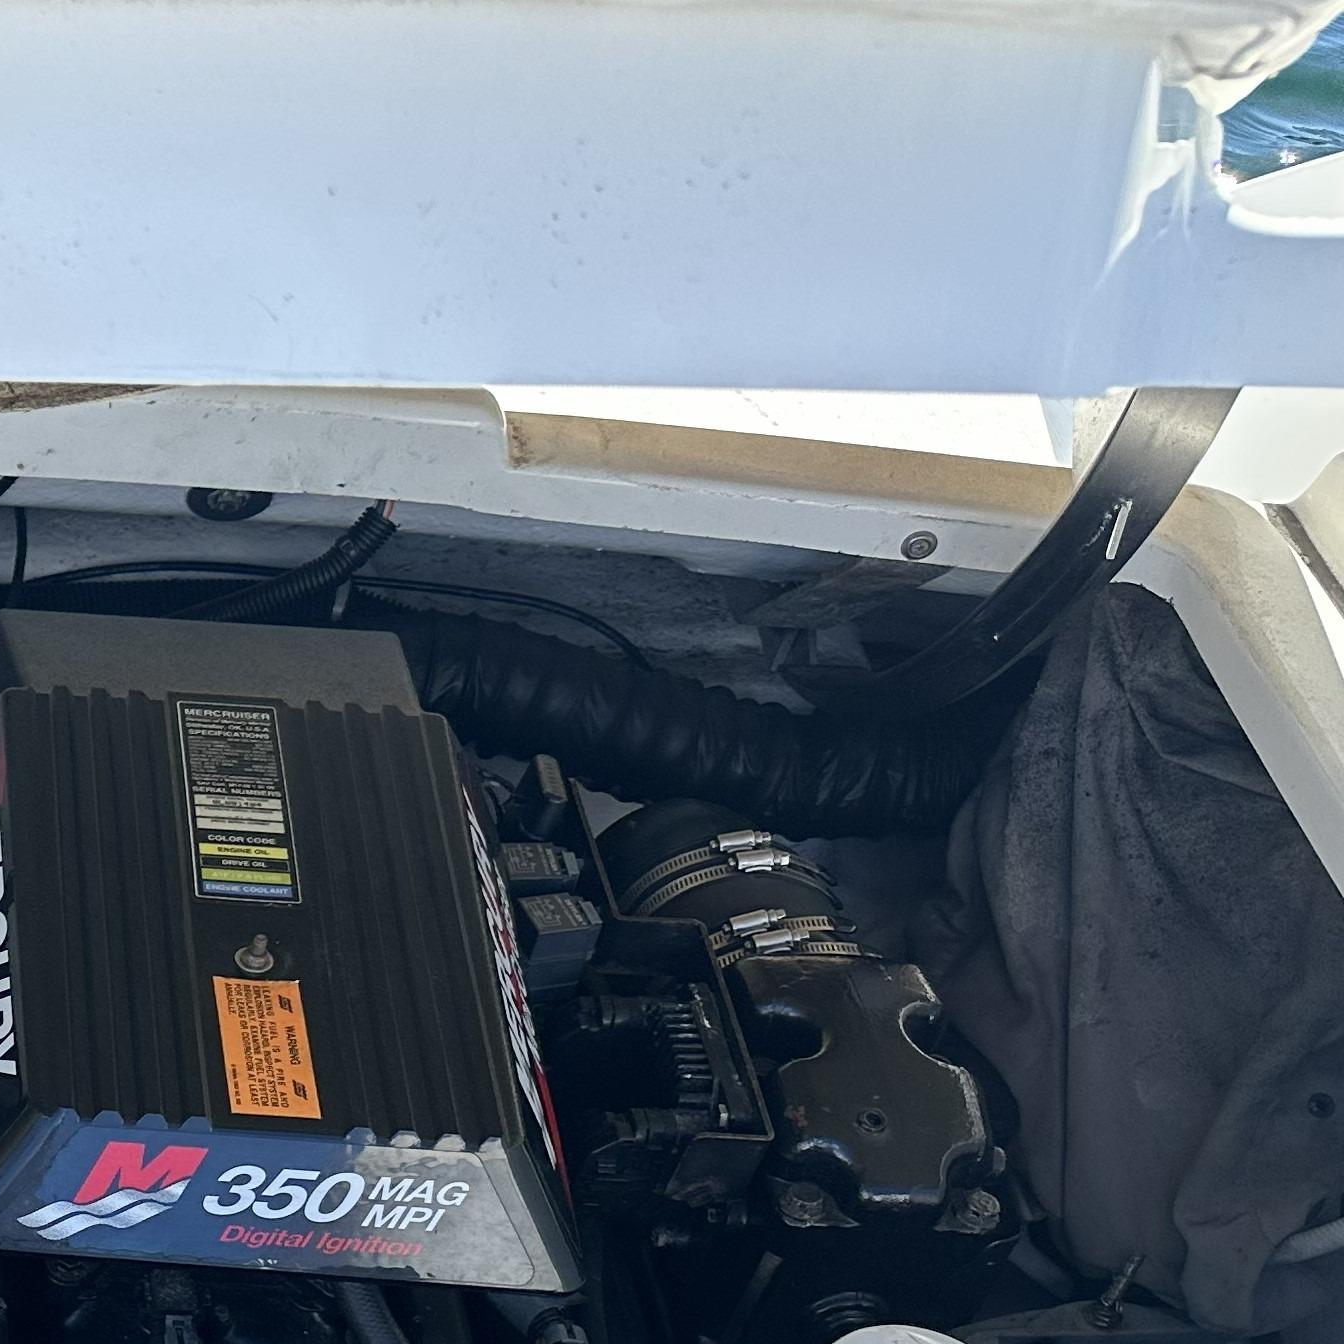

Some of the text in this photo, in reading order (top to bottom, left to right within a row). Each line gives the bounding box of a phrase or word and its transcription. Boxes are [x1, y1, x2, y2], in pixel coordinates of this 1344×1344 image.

[184, 707, 271, 721] MERCRUISER
[188, 729, 270, 740] SPECIFICATIONS
[231, 787, 282, 798] NUMBERS
[207, 834, 276, 845] COLOR CODE
[217, 846, 270, 856] ENGINE OIL
[221, 859, 267, 868] DRIVE OIL
[205, 883, 290, 895] ENGINE COOLANT
[262, 985, 275, 1016] LEAKING
[267, 1021, 278, 1040] FUEL
[233, 983, 259, 1106] FOR LEAKS OR CORROSION AT LEAST
[284, 1025, 300, 1065] WARNING
[254, 1057, 264, 1075] FUEL
[274, 1068, 285, 1085] FIRE
[256, 1078, 269, 1106] SYSTEM
[267, 1080, 279, 1107] SYSTEM
[279, 1091, 288, 1107] AND
[202, 1165, 470, 1223] 350 MAG
[360, 1204, 446, 1233] MPI
[219, 1224, 422, 1258] Digital Ignition
